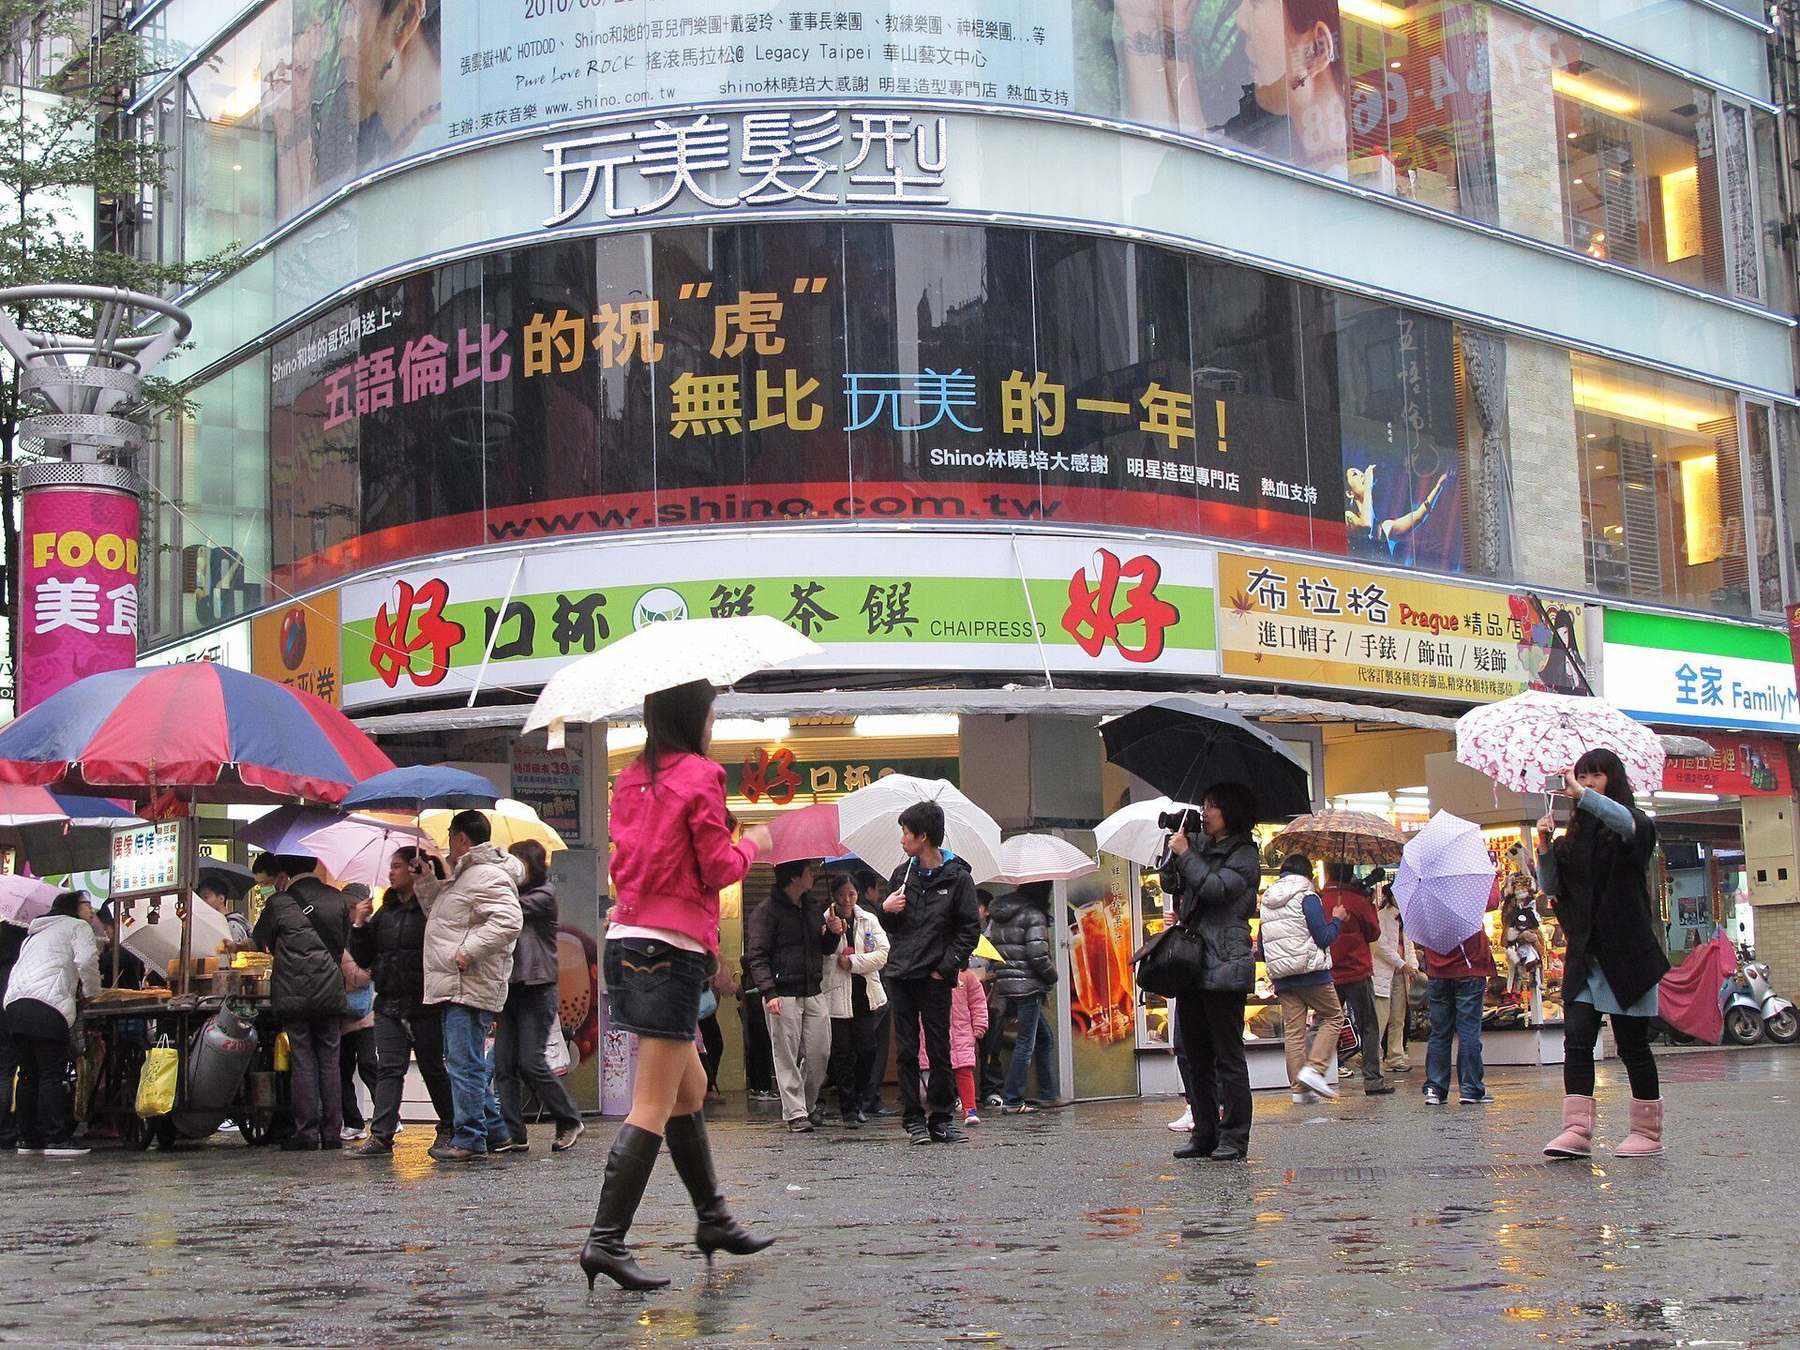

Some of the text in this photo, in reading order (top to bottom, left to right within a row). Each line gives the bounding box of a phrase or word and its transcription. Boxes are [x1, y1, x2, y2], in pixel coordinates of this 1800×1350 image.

[515, 74, 546, 91] Pure
[551, 66, 581, 86] Love
[587, 55, 638, 76] ROCK
[756, 44, 810, 62] Legacy
[819, 43, 872, 61] Taipei
[883, 44, 988, 68] 華山藝文中心
[544, 87, 676, 115] www.shino.com.tw
[879, 77, 998, 98] 明星造型專門店
[1007, 83, 1070, 106] 熱血支持
[542, 112, 951, 228] 玩美髮型
[929, 447, 1318, 505] Shino林曉培大感謝 明星造型專門店 熱血支持
[487, 493, 1061, 541] www.shino.com.tw
[1247, 567, 1522, 641] 布拉格 Prague 精品店
[930, 619, 1047, 639] CHAIPRESSO
[1258, 620, 1337, 655] 進口帽子
[1359, 633, 1397, 662] 手錶
[1418, 639, 1453, 668] 飾品
[1473, 646, 1507, 673] 髮飾
[1675, 663, 1724, 706] 全家
